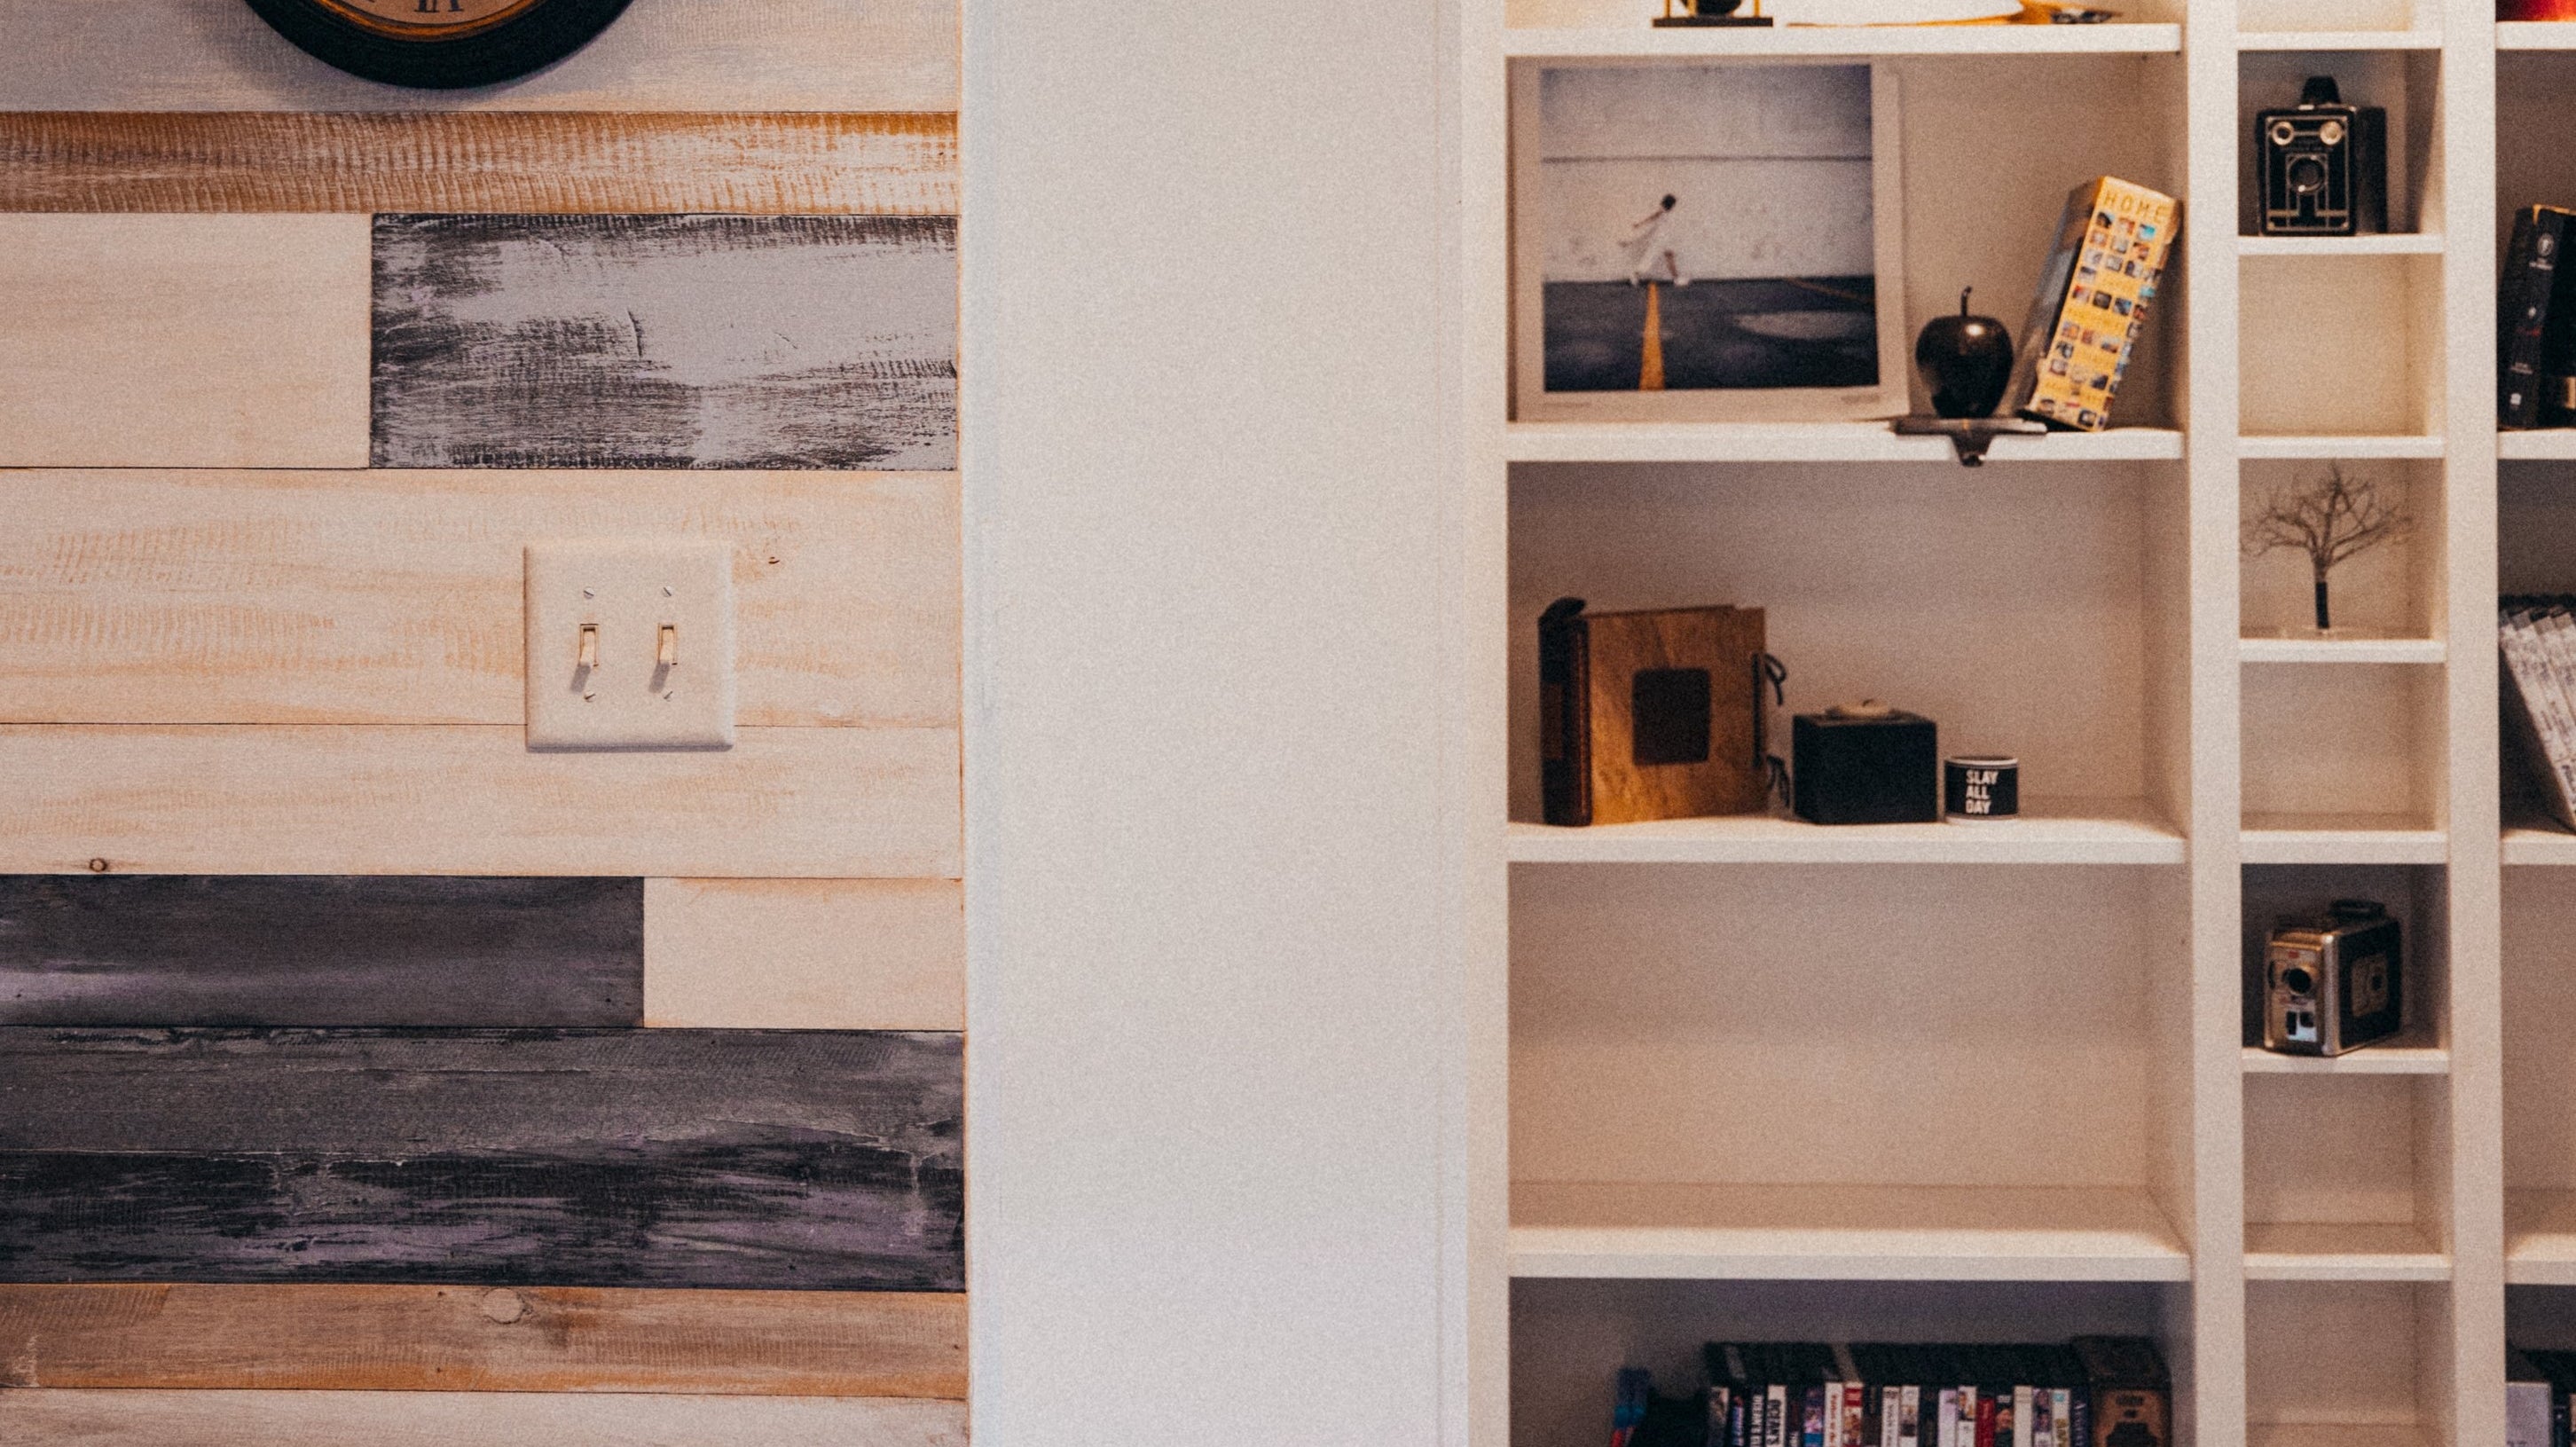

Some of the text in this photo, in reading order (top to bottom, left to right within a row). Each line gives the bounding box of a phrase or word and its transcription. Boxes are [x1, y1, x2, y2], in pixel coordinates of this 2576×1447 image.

[2103, 190, 2171, 224] HOME
[1966, 769, 1999, 785] SLAY
[1966, 785, 1991, 799] ALL
[1966, 799, 1991, 814] DAY
